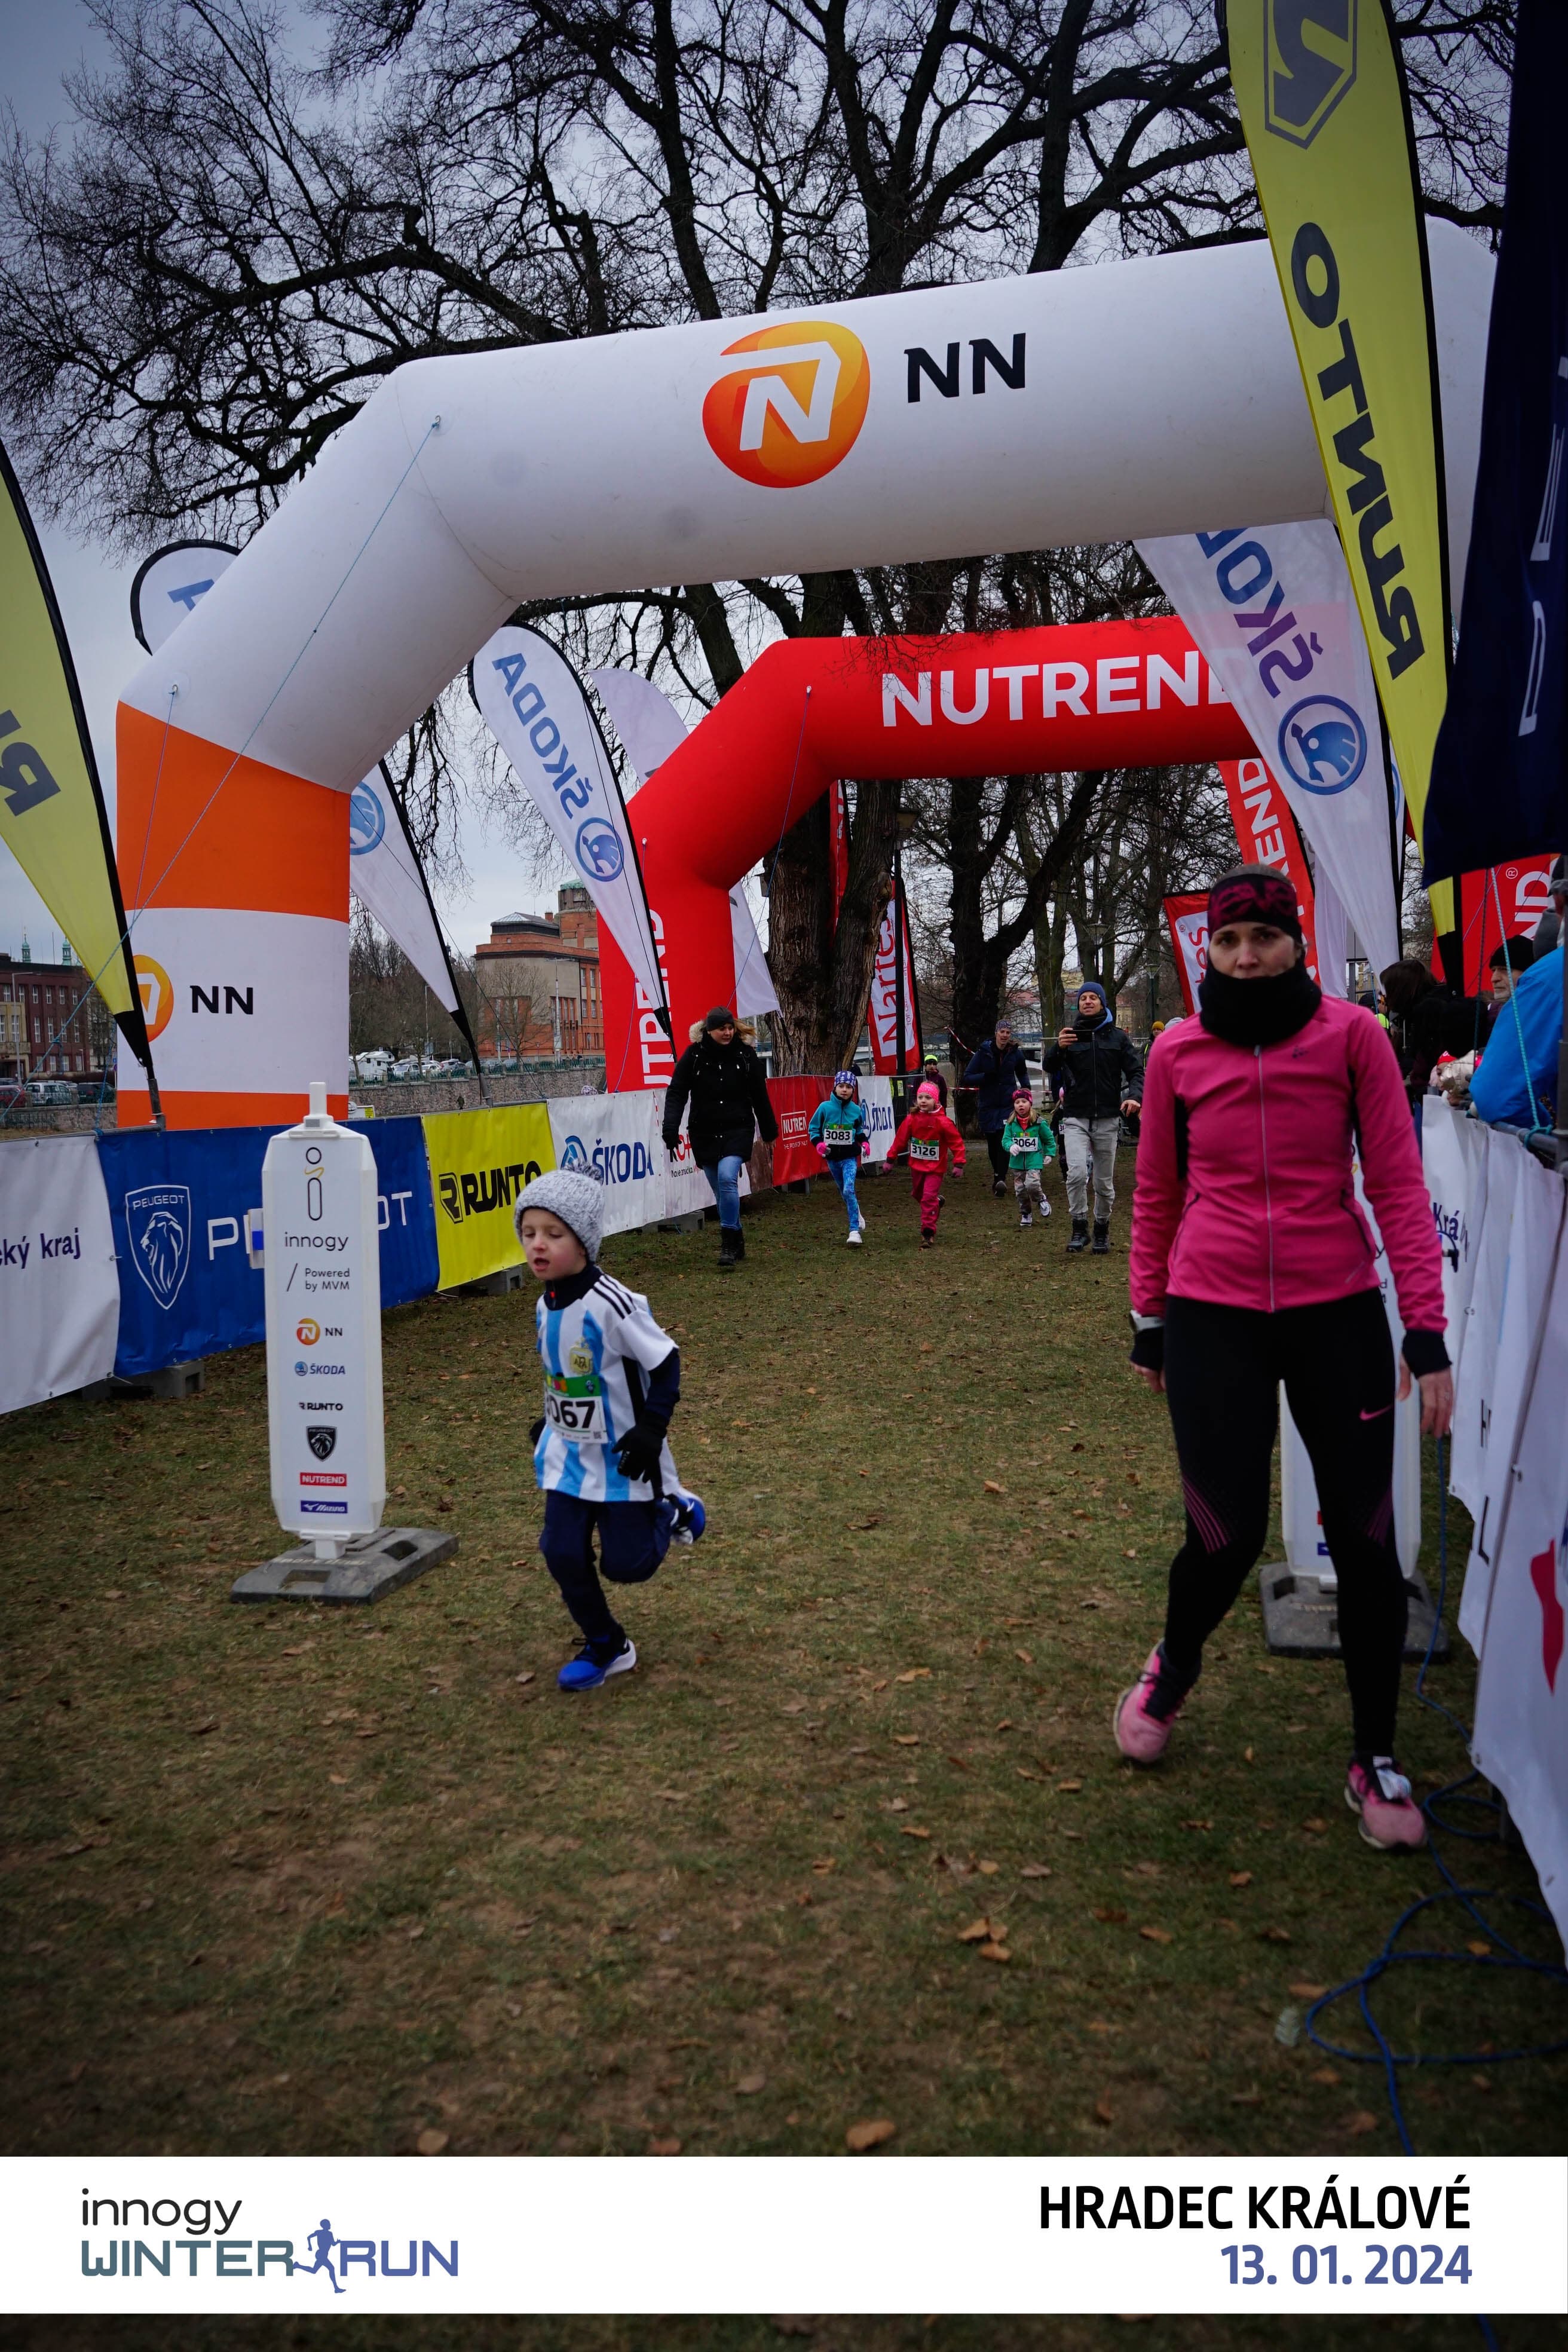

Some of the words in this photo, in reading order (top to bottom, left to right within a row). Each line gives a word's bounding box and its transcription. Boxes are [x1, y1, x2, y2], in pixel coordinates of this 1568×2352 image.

[903, 332, 1026, 403] NN
[881, 650, 1233, 727] NUTREN
[189, 985, 253, 1015] NN
[783, 1116, 807, 1134] NUTREN
[825, 1130, 850, 1141] 3083
[1013, 1138, 1036, 1147] 3064
[911, 1144, 936, 1156] 3126
[592, 1138, 654, 1186] ŠKODA
[133, 1195, 185, 1211] PEUGEOT
[39, 1227, 81, 1260] kraj
[284, 1232, 349, 1251] innogy
[305, 1267, 350, 1277] Powered
[305, 1280, 318, 1292] by
[322, 1281, 350, 1290] MVM
[324, 1327, 343, 1336] NN
[310, 1363, 345, 1375] ŠKODA
[307, 1402, 344, 1411] RUNTO
[547, 1394, 596, 1429] 067
[302, 1475, 345, 1484] NUTREND
